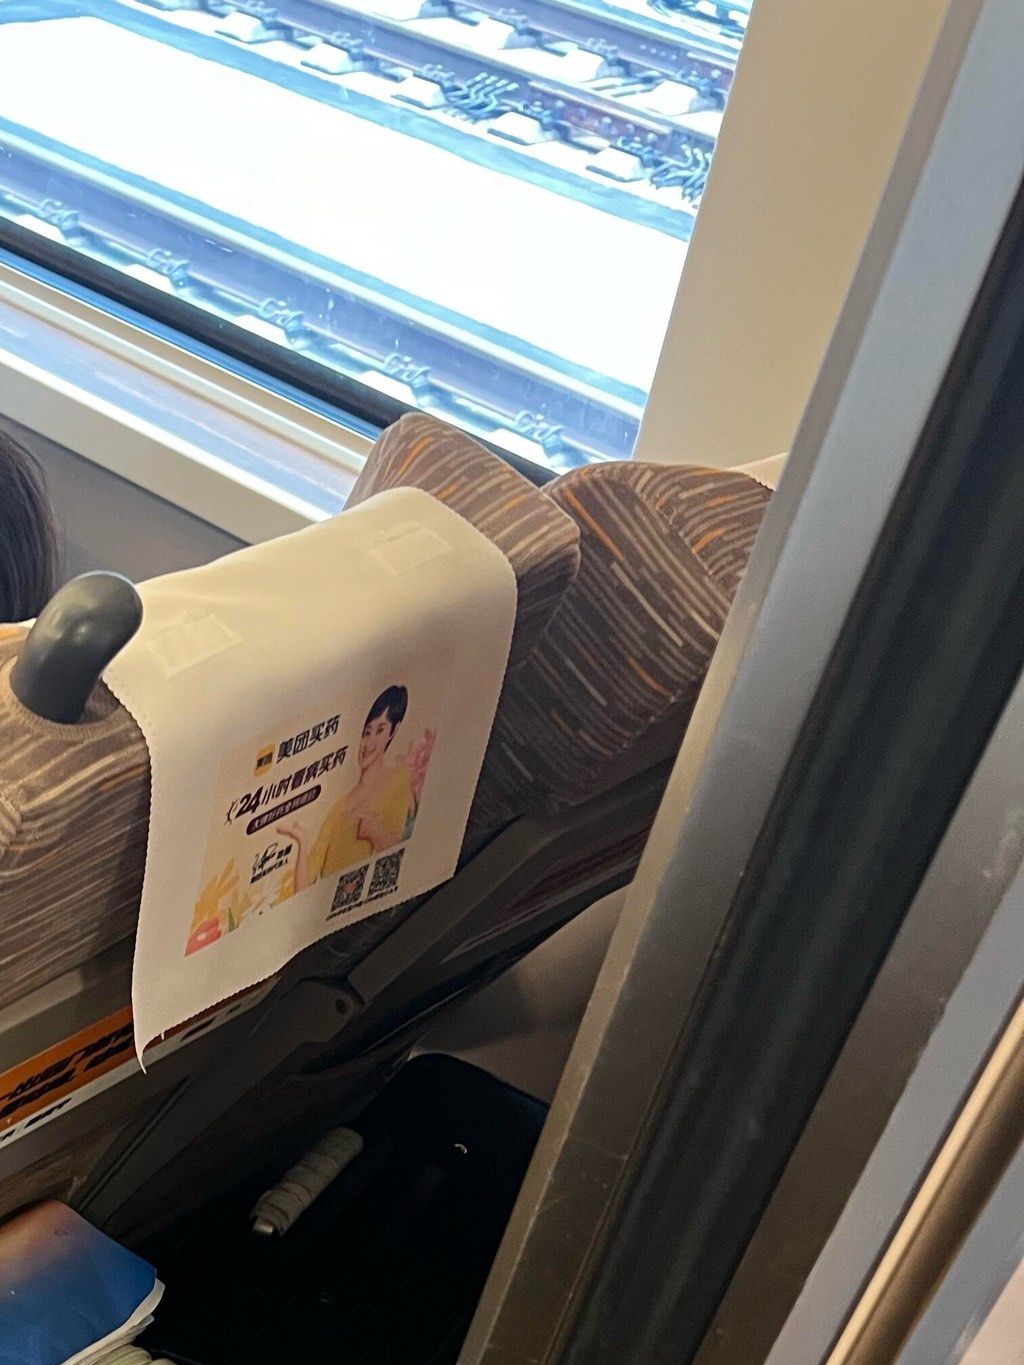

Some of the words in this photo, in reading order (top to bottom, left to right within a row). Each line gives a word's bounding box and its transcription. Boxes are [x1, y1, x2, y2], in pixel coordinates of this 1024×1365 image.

[276, 715, 341, 763] 美团买药
[234, 745, 350, 820] 24小时看病买药
